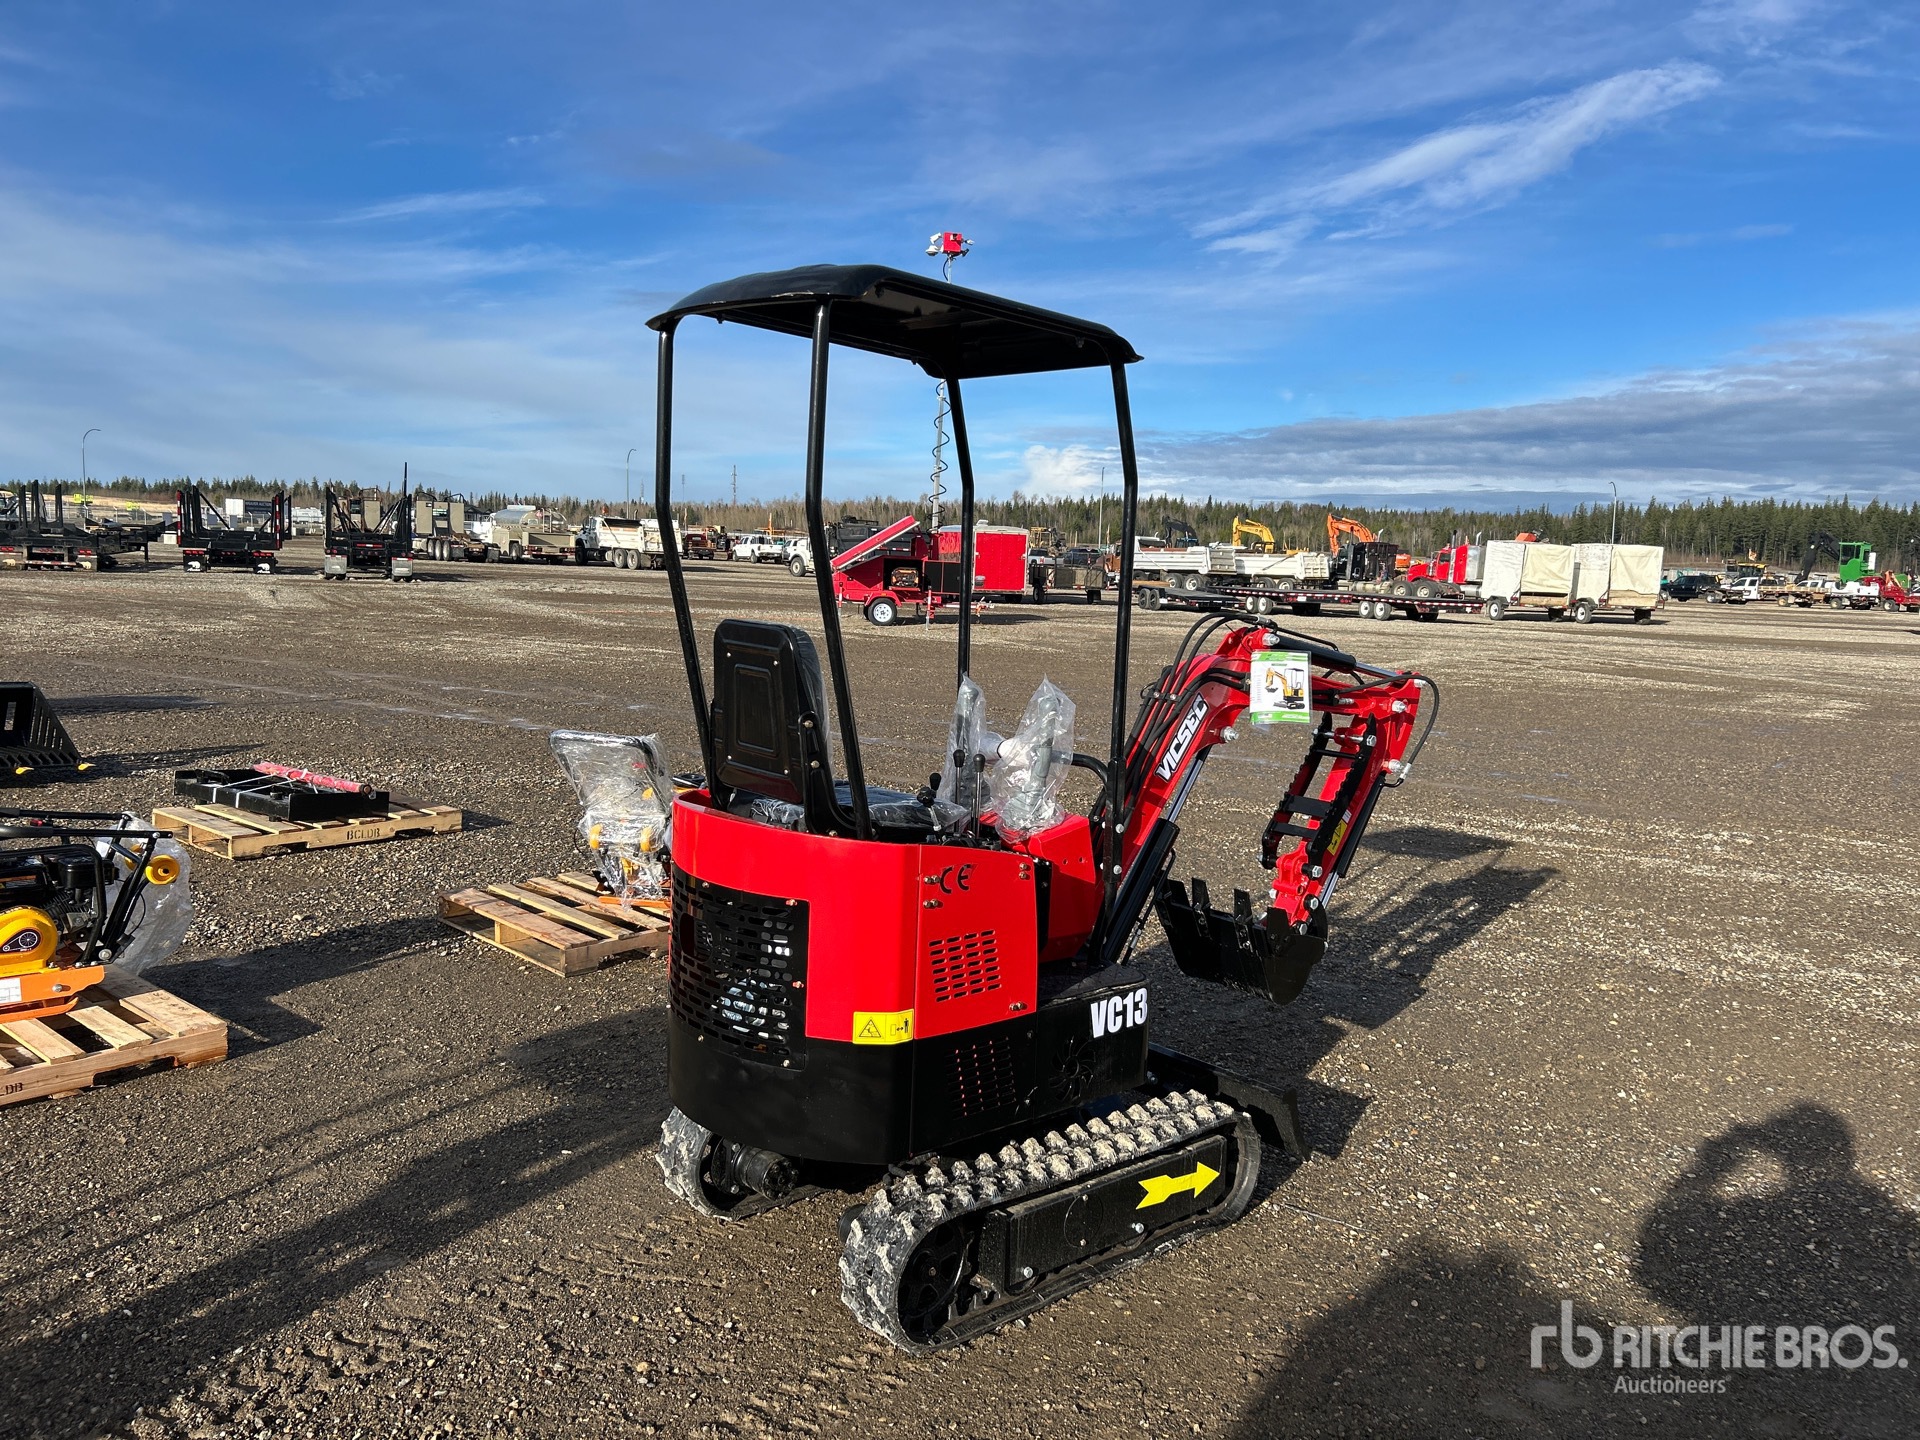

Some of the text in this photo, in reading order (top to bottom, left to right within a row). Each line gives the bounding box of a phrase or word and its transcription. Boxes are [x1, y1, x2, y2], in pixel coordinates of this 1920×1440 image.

[1155, 693, 1208, 781] VICSEC
[347, 827, 380, 841] BCLDB
[939, 863, 971, 894] CE
[1090, 987, 1148, 1039] VC13
